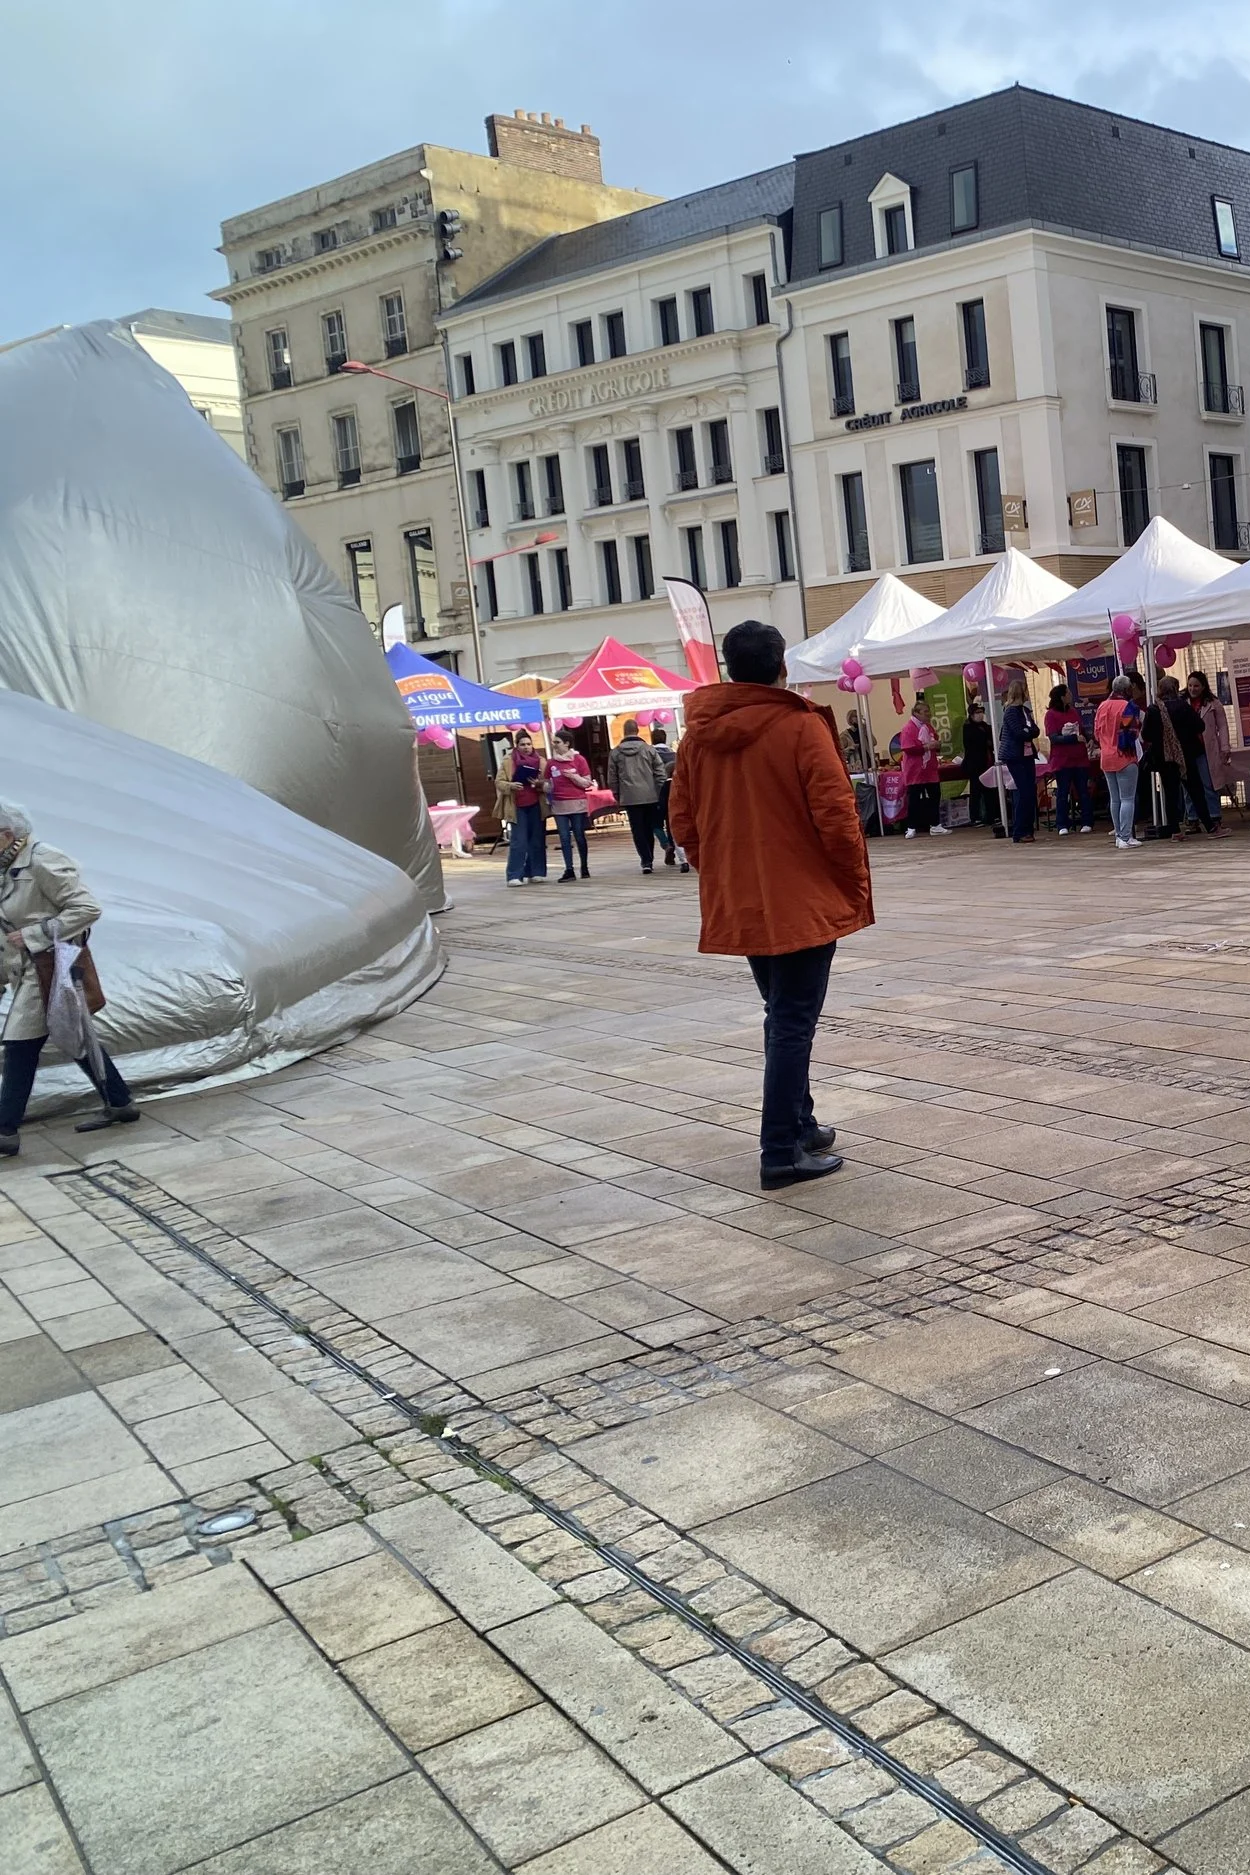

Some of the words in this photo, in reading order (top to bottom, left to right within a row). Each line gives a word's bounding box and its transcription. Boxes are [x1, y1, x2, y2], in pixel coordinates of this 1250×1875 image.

[589, 367, 670, 403] AGRICOLE
[900, 396, 968, 421] AGRICOLE
[459, 712, 472, 723] LE
[474, 708, 521, 722] CANCER
